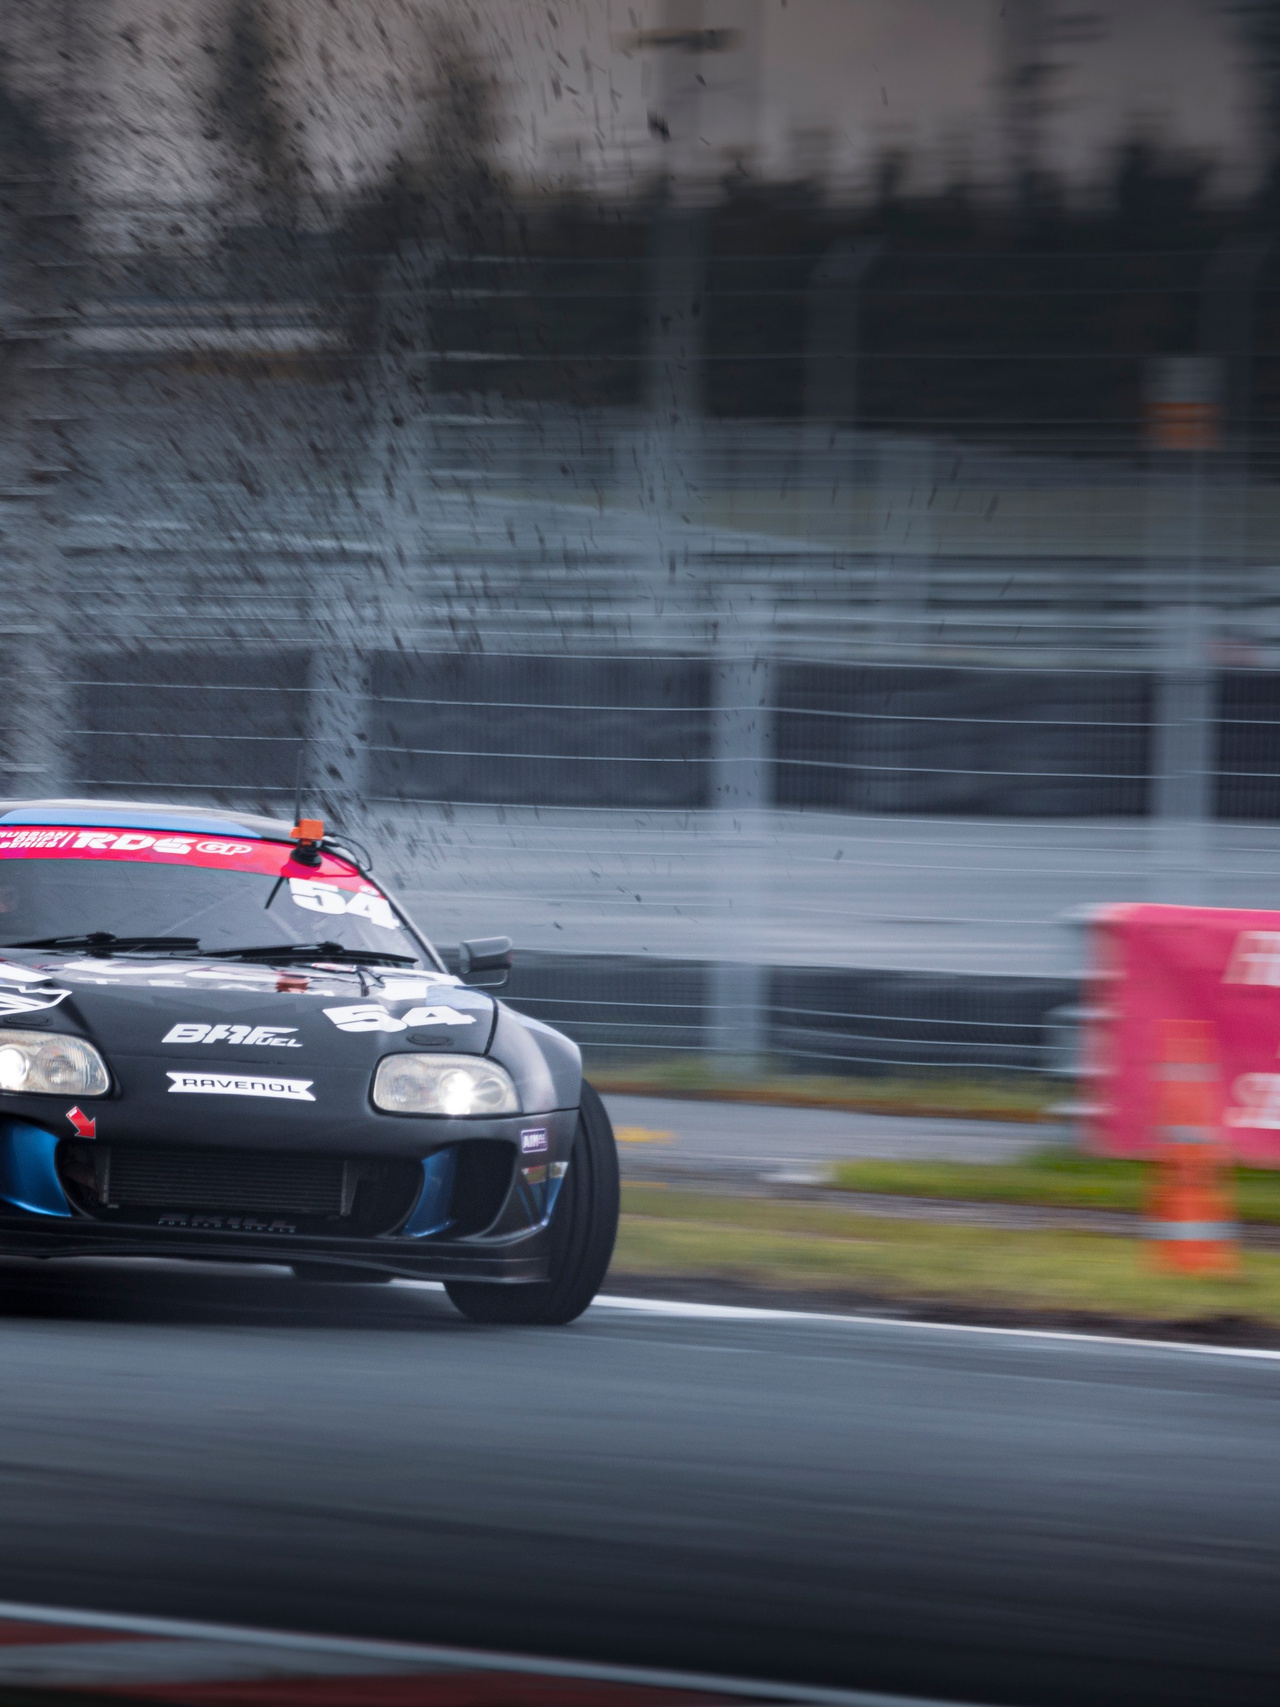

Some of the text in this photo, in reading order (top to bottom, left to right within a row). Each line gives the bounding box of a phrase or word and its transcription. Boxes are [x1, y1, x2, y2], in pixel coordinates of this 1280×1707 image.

[71, 832, 198, 855] RDS
[289, 877, 401, 930] 54
[322, 1004, 477, 1033] 54
[182, 1078, 301, 1094] RAVENOL
